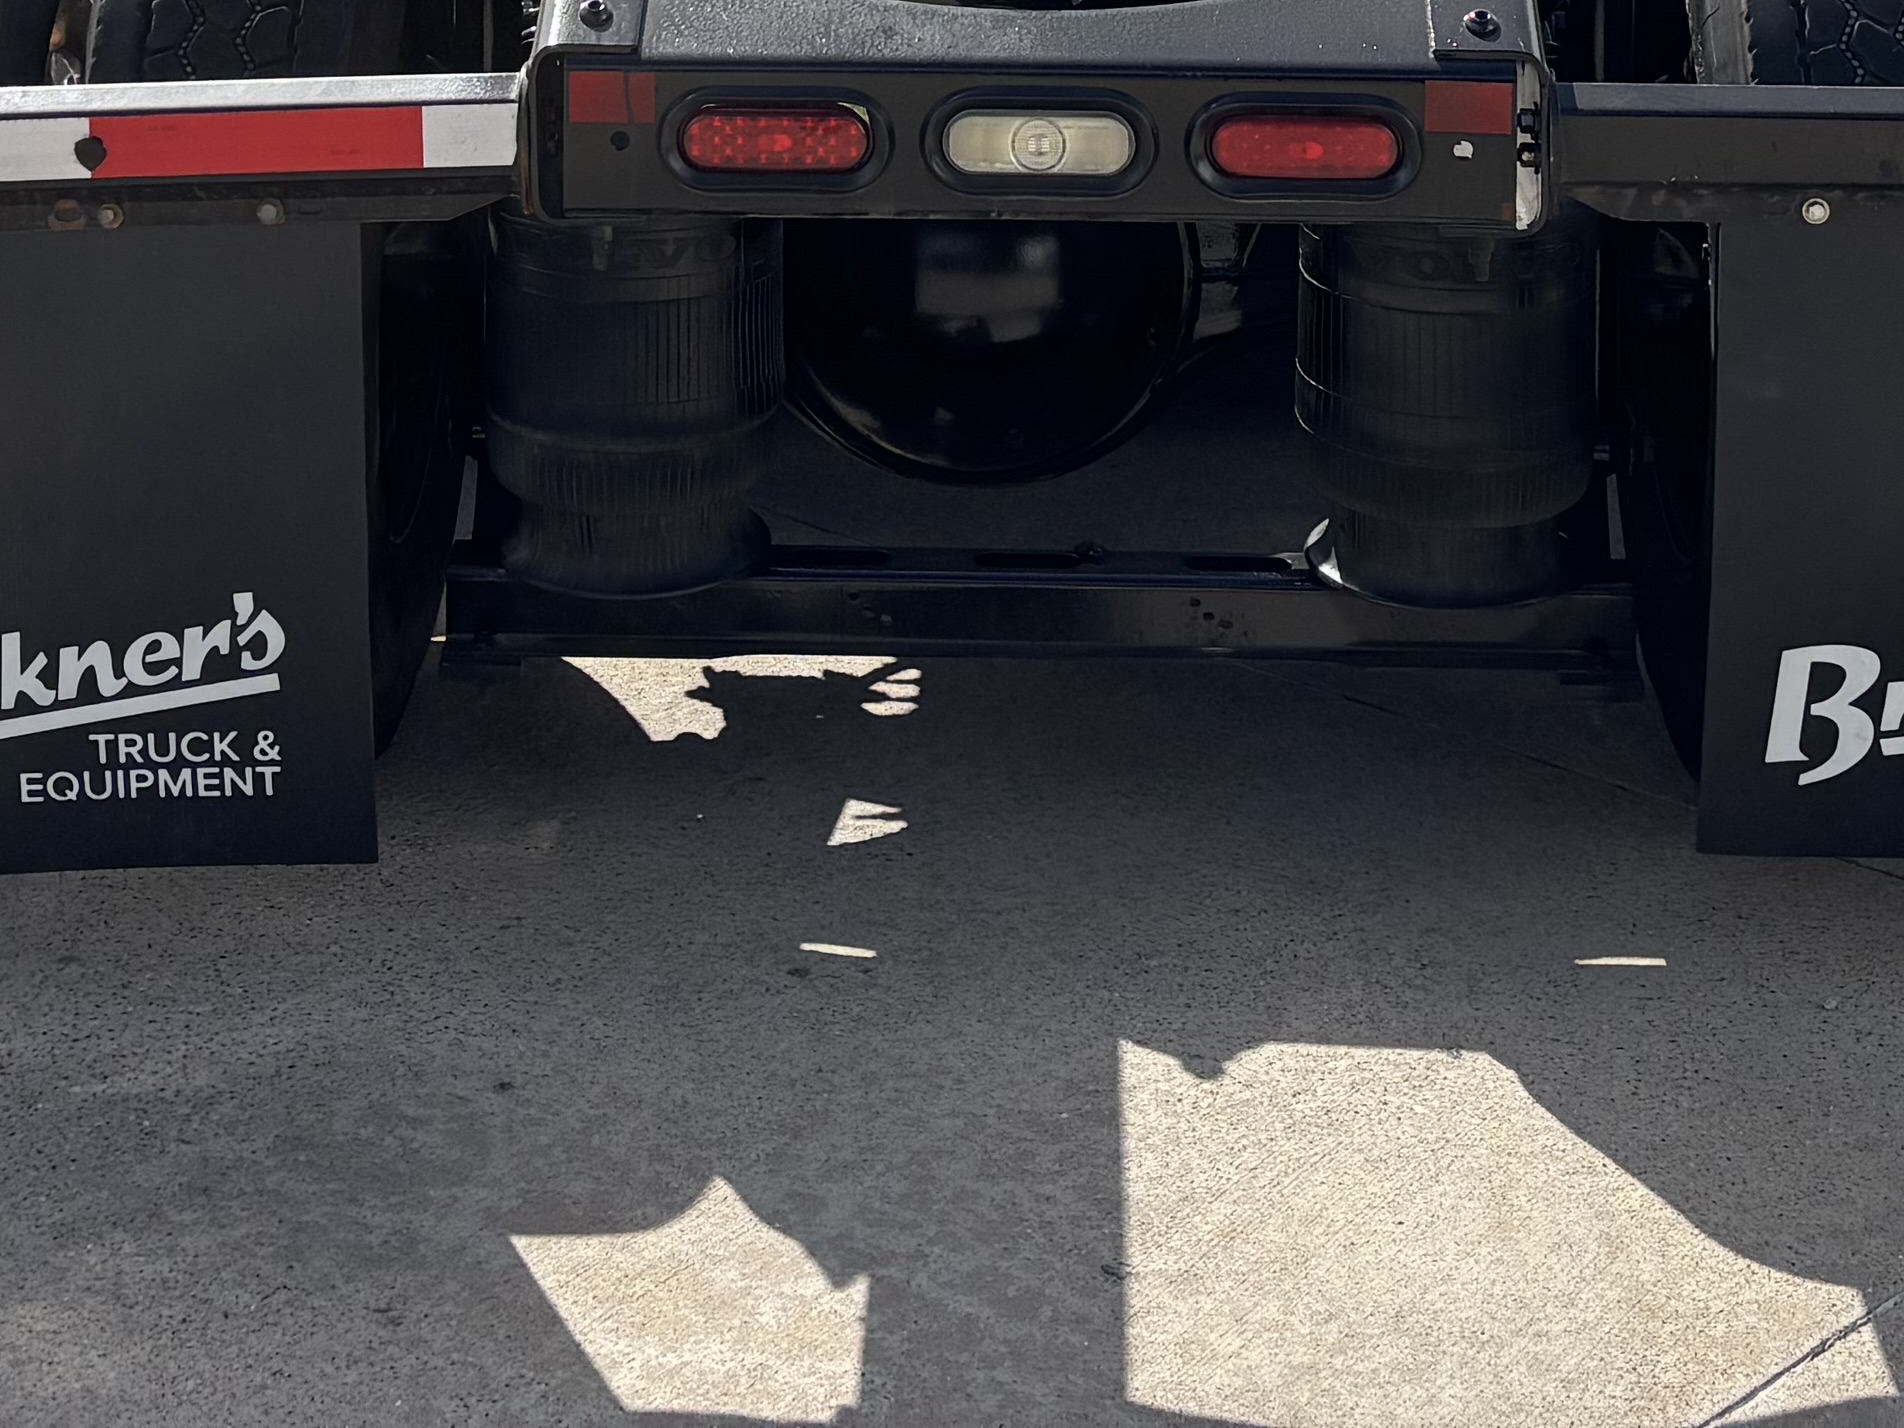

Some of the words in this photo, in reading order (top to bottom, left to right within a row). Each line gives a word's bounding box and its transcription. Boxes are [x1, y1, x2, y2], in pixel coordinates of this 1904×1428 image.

[88, 730, 242, 764] TRUCK
[253, 730, 283, 762] &
[19, 766, 283, 803] EQUIPMENT
